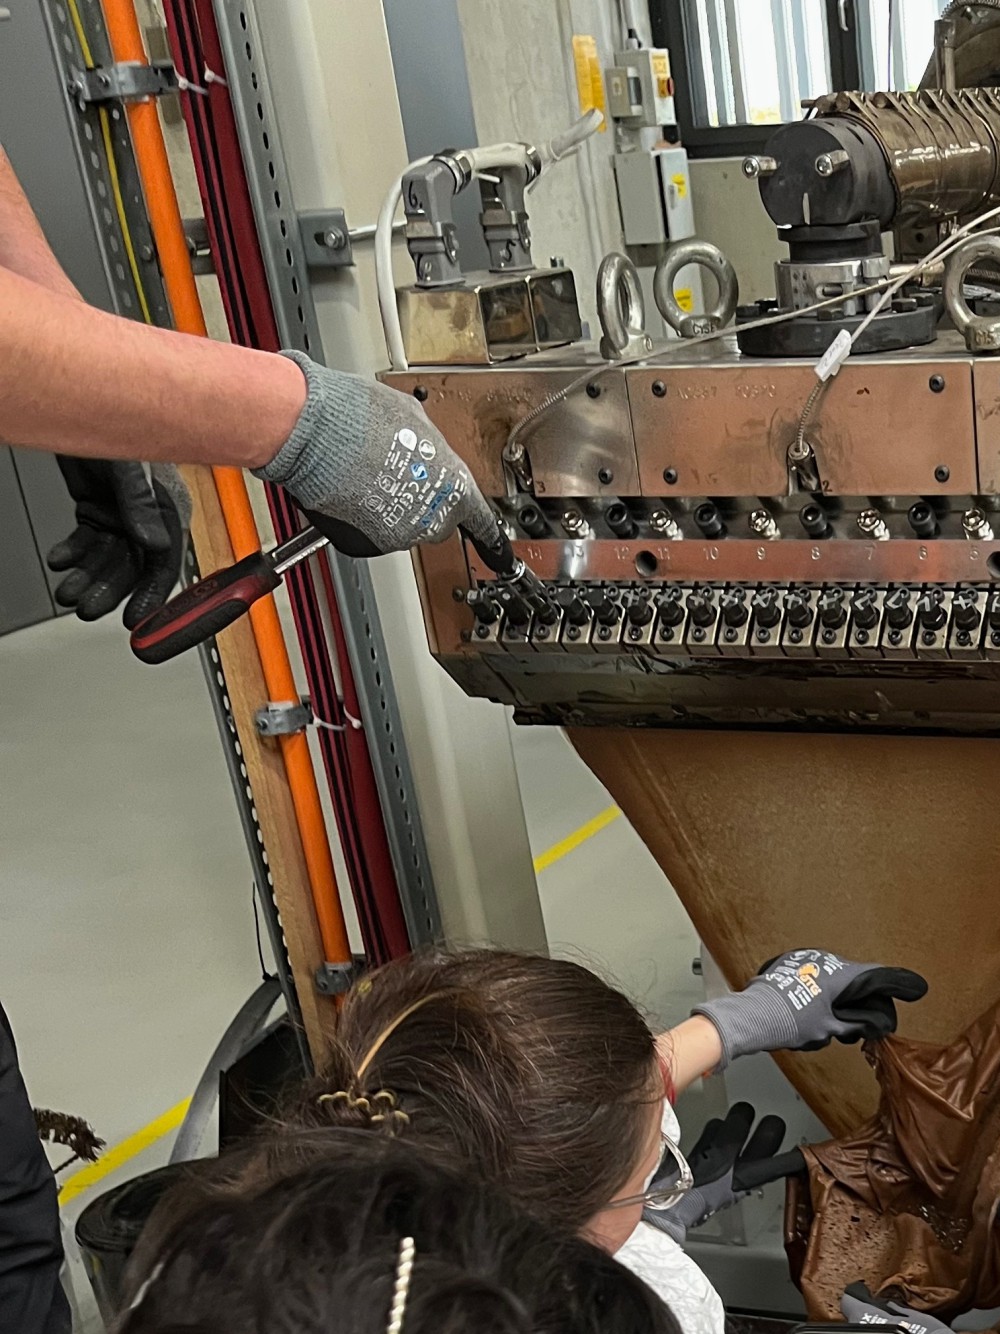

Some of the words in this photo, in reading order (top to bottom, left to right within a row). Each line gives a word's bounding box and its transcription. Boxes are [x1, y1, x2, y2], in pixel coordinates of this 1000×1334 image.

[822, 479, 833, 493] 2
[657, 547, 671, 560] 11
[702, 546, 719, 560] 10
[756, 546, 766, 560] 9
[811, 546, 821, 560] 8
